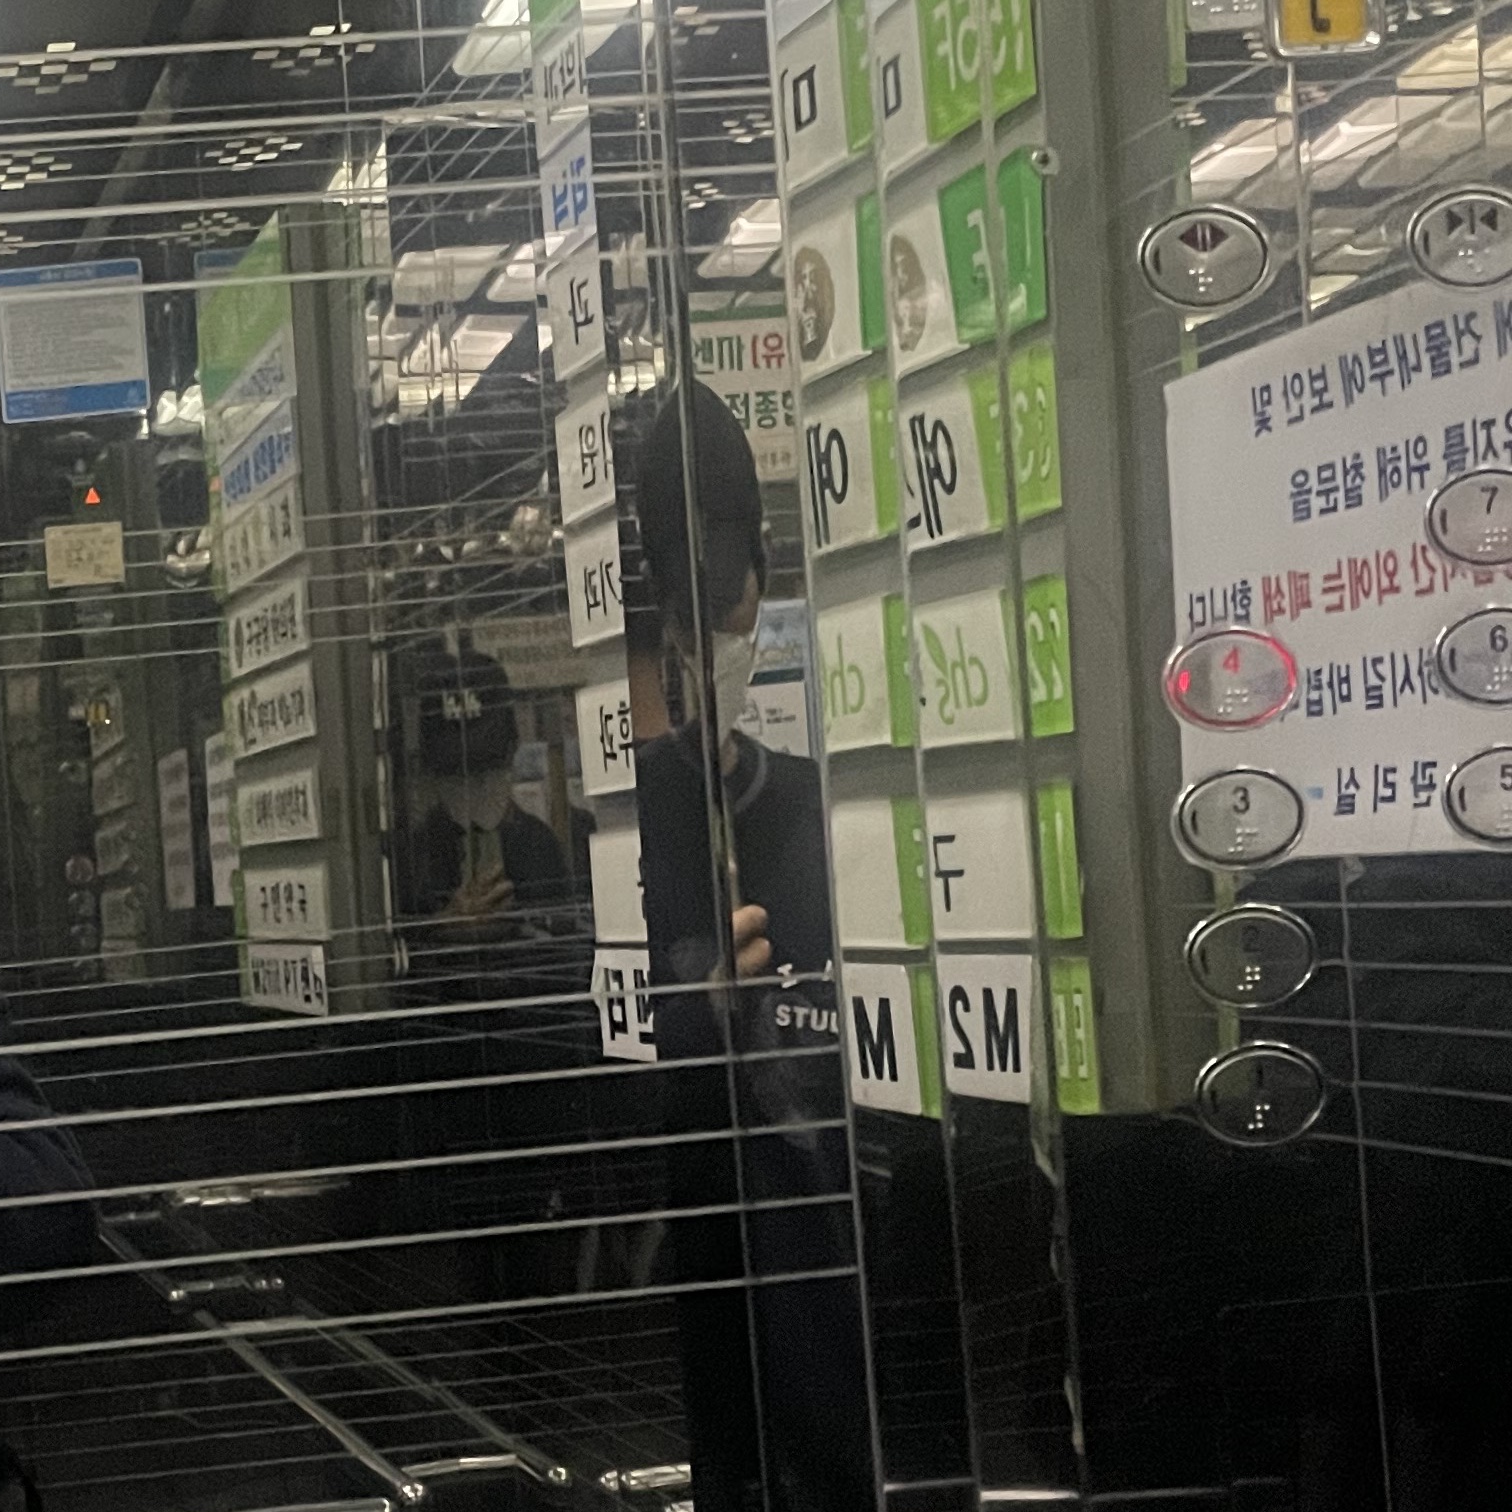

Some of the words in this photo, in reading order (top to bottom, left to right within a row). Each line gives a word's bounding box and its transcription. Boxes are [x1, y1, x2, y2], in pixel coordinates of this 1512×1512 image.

[1481, 486, 1498, 515] 7
[1489, 624, 1507, 652] 6
[1222, 647, 1241, 675] 4
[1232, 786, 1251, 815] 3
